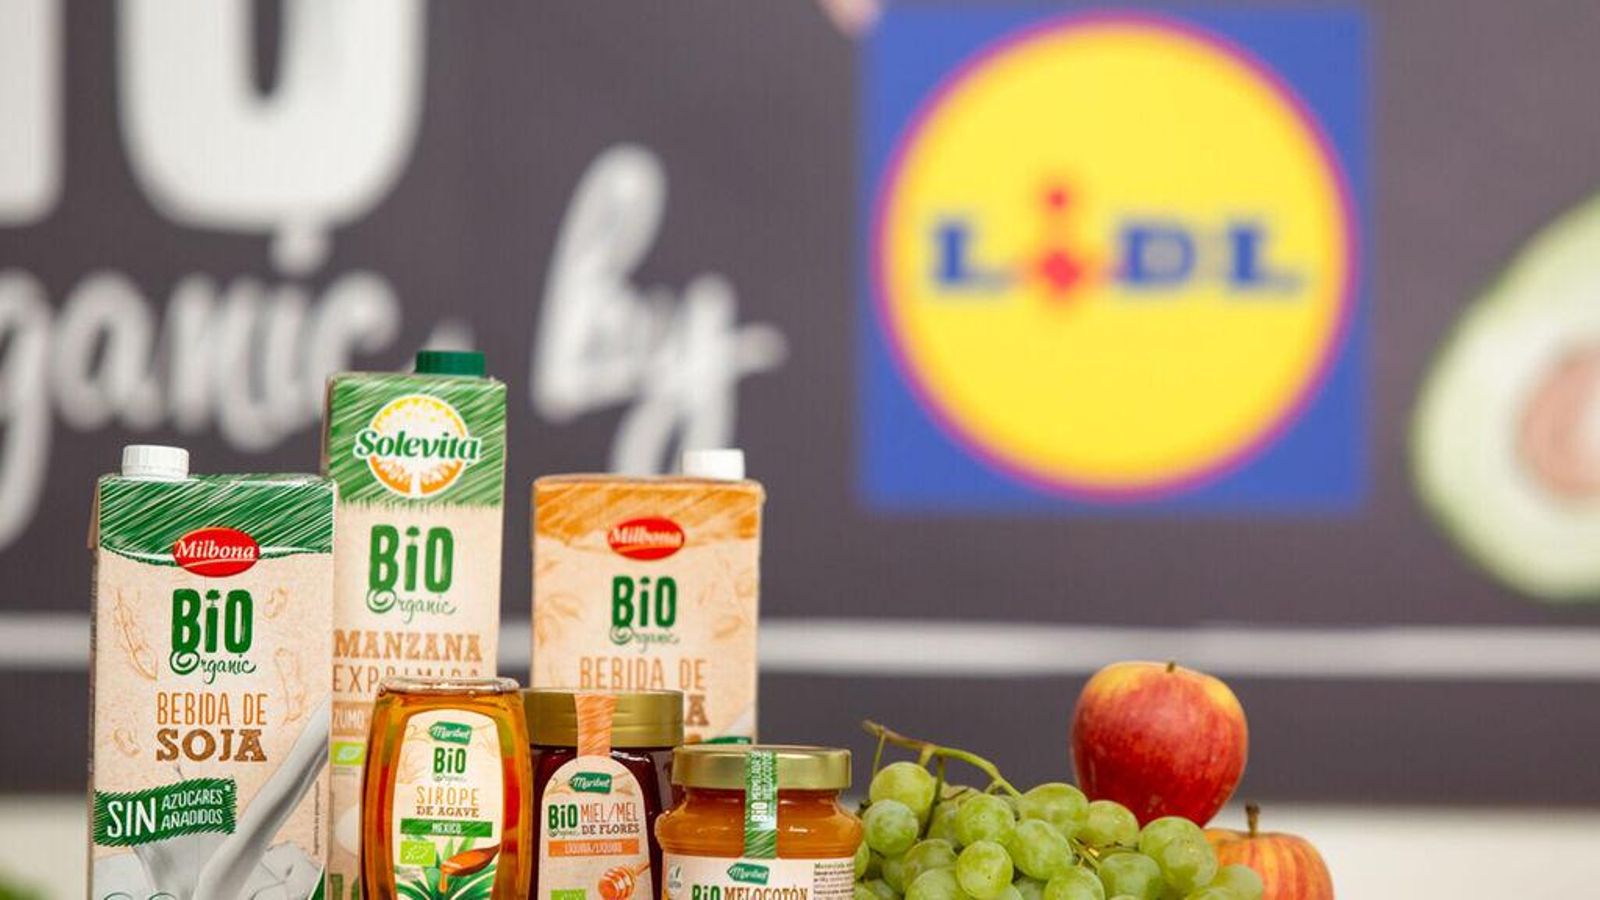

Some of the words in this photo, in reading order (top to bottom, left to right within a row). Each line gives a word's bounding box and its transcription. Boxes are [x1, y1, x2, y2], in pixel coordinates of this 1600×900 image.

[533, 145, 785, 475] by
[355, 430, 480, 461] Solevita
[174, 540, 256, 561] Milbona
[610, 525, 683, 546] Milbona
[367, 586, 456, 624] Organic
[333, 629, 483, 663] MANZANA
[169, 650, 256, 685] Organic
[580, 656, 665, 690] BEBIDA
[679, 659, 707, 689] DE
[156, 692, 231, 725] BEBIDA
[243, 693, 268, 726] DE
[156, 728, 267, 762] SOJA
[416, 785, 479, 806] SIROPE
[416, 805, 434, 816] DE
[438, 807, 479, 818] AGAVE
[107, 799, 156, 838] SIN
[160, 808, 223, 831] AÑADIDOS
[581, 824, 596, 835] DE
[599, 823, 639, 835] FLORES
